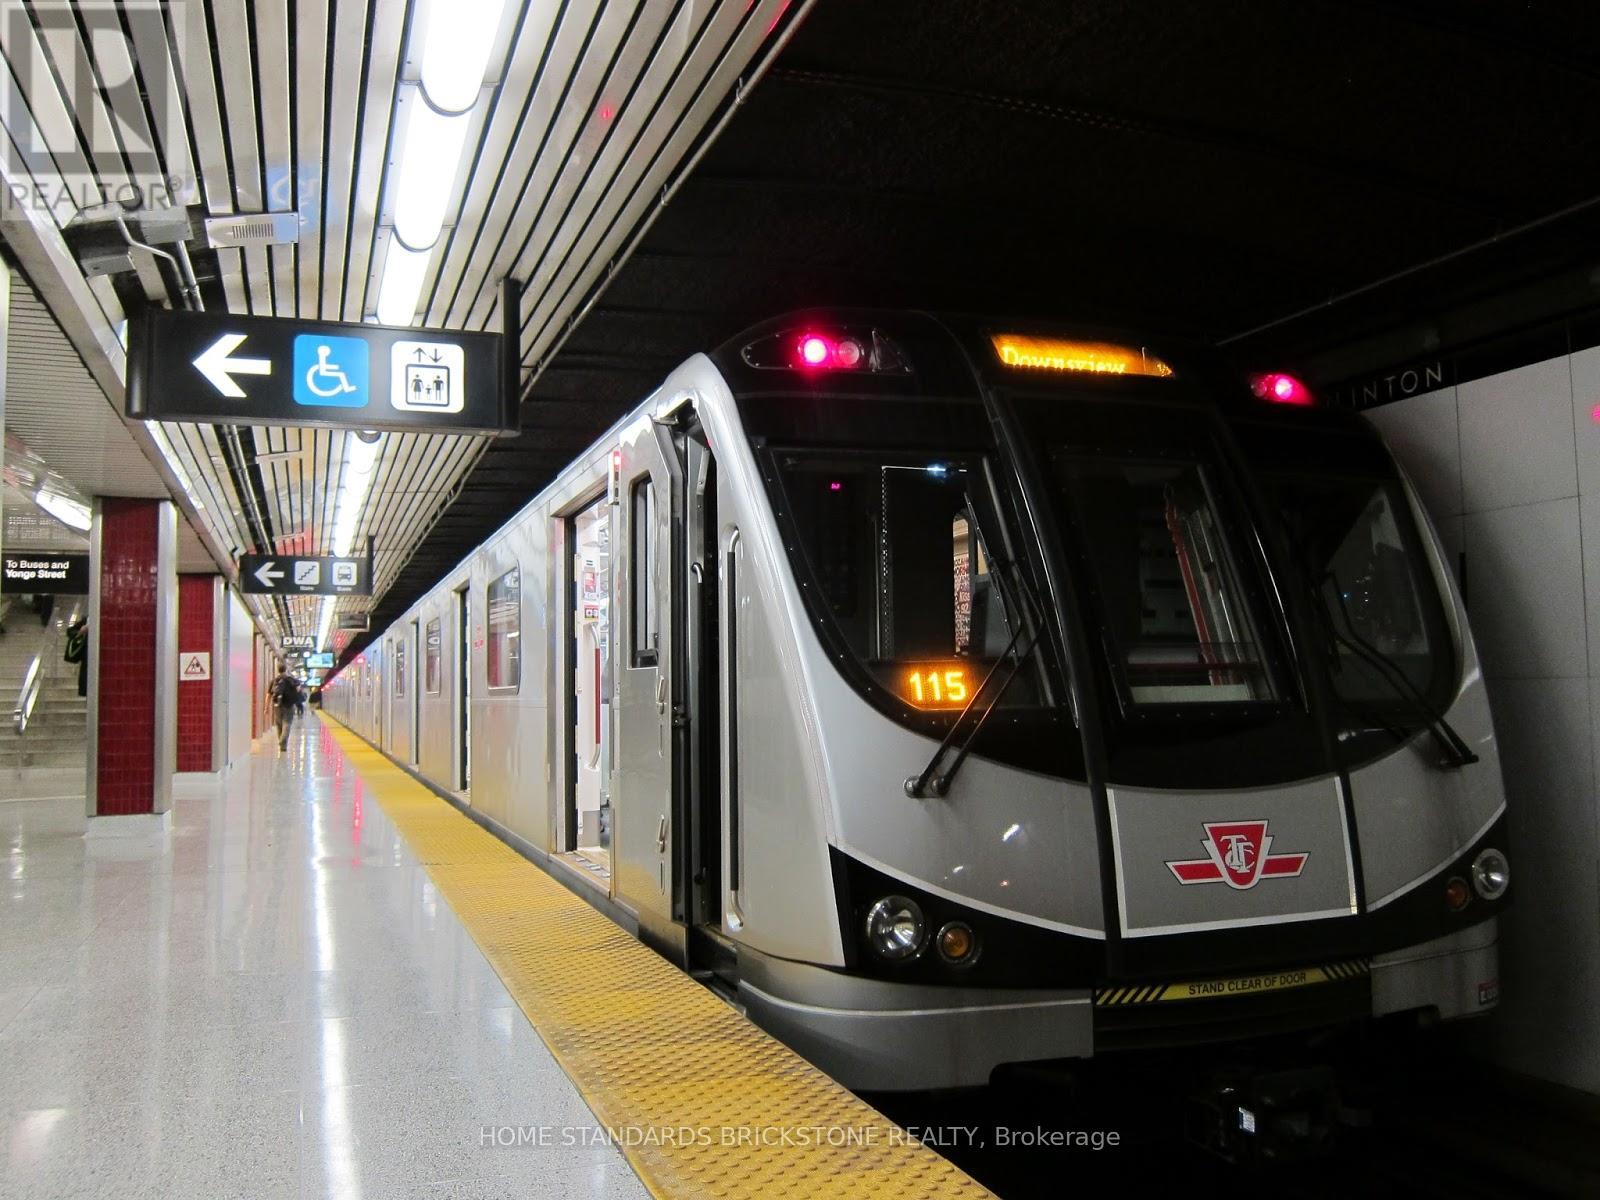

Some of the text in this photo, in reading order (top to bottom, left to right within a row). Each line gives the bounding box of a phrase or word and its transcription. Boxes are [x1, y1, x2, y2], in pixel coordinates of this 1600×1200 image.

[1001, 345, 1127, 375] Downsview
[6, 560, 70, 569] To Buses and
[6, 569, 67, 580] Yonge Street
[909, 671, 967, 702] 115
[1188, 972, 1306, 996] STAND CLEAR OF DOOR
